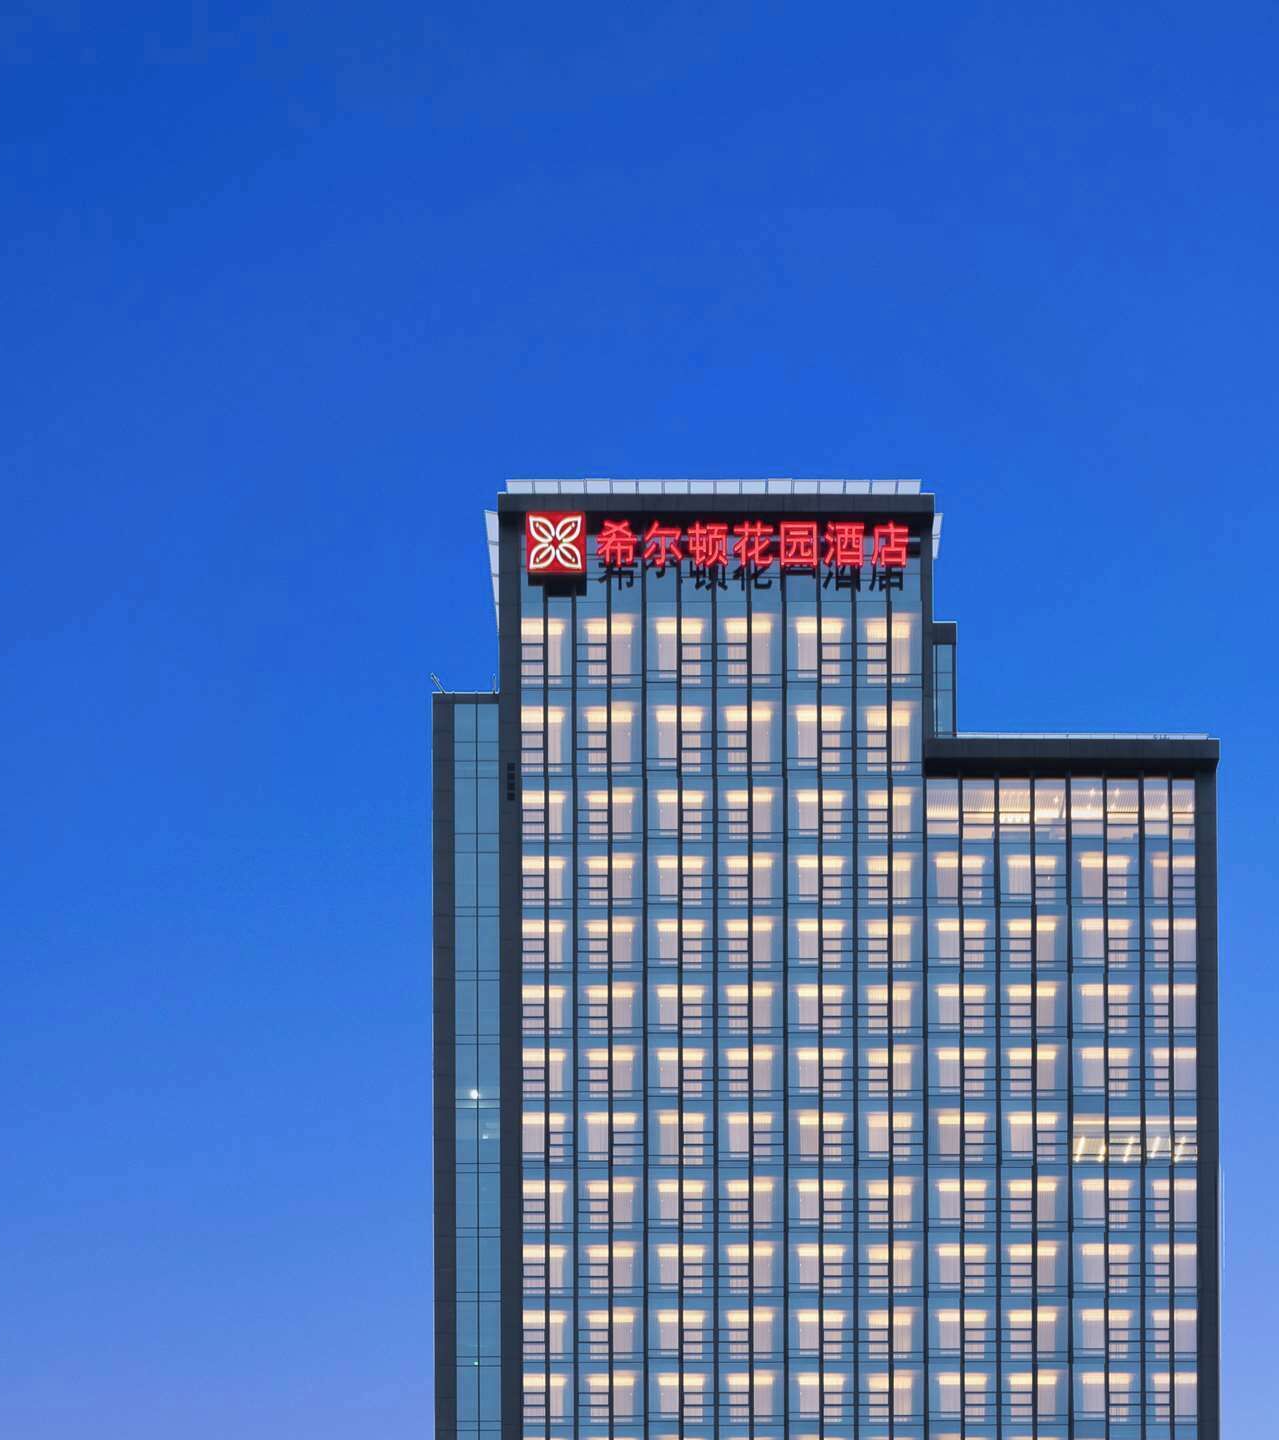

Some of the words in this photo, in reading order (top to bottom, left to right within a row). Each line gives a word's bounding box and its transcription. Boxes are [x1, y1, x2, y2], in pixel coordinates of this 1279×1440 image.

[595, 519, 910, 568] 希尔顿花园酒店
